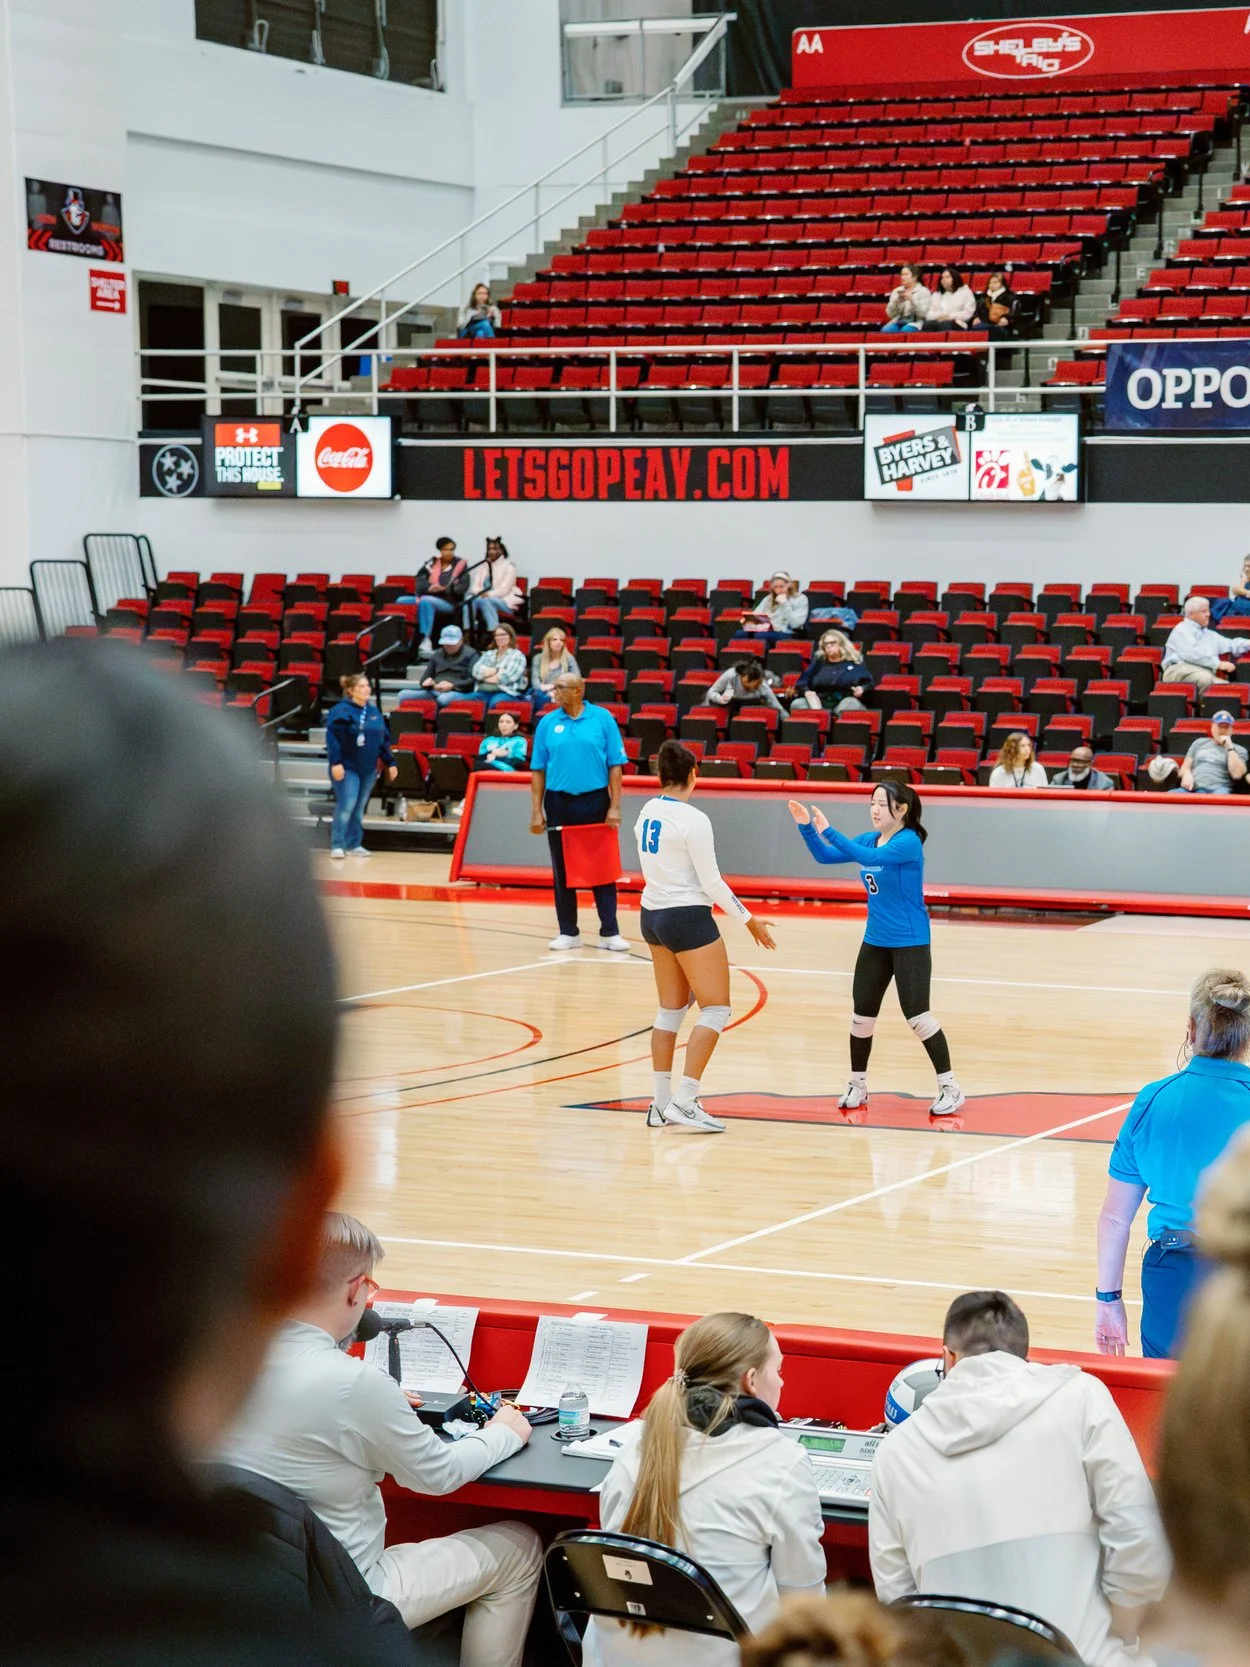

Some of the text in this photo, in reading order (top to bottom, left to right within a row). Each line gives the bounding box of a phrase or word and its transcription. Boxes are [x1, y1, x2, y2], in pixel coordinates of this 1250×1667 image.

[797, 34, 824, 54] AA
[964, 415, 977, 432] B
[215, 446, 284, 467] PROTECT
[317, 446, 368, 469] Coca-Cola
[878, 435, 950, 466] BYERS &
[215, 466, 284, 483] THIS HOUSE.
[464, 447, 790, 500] LETSGOPEAY.COM
[881, 447, 955, 483] HARVEY
[642, 819, 662, 854] 13
[865, 873, 879, 895] 3
